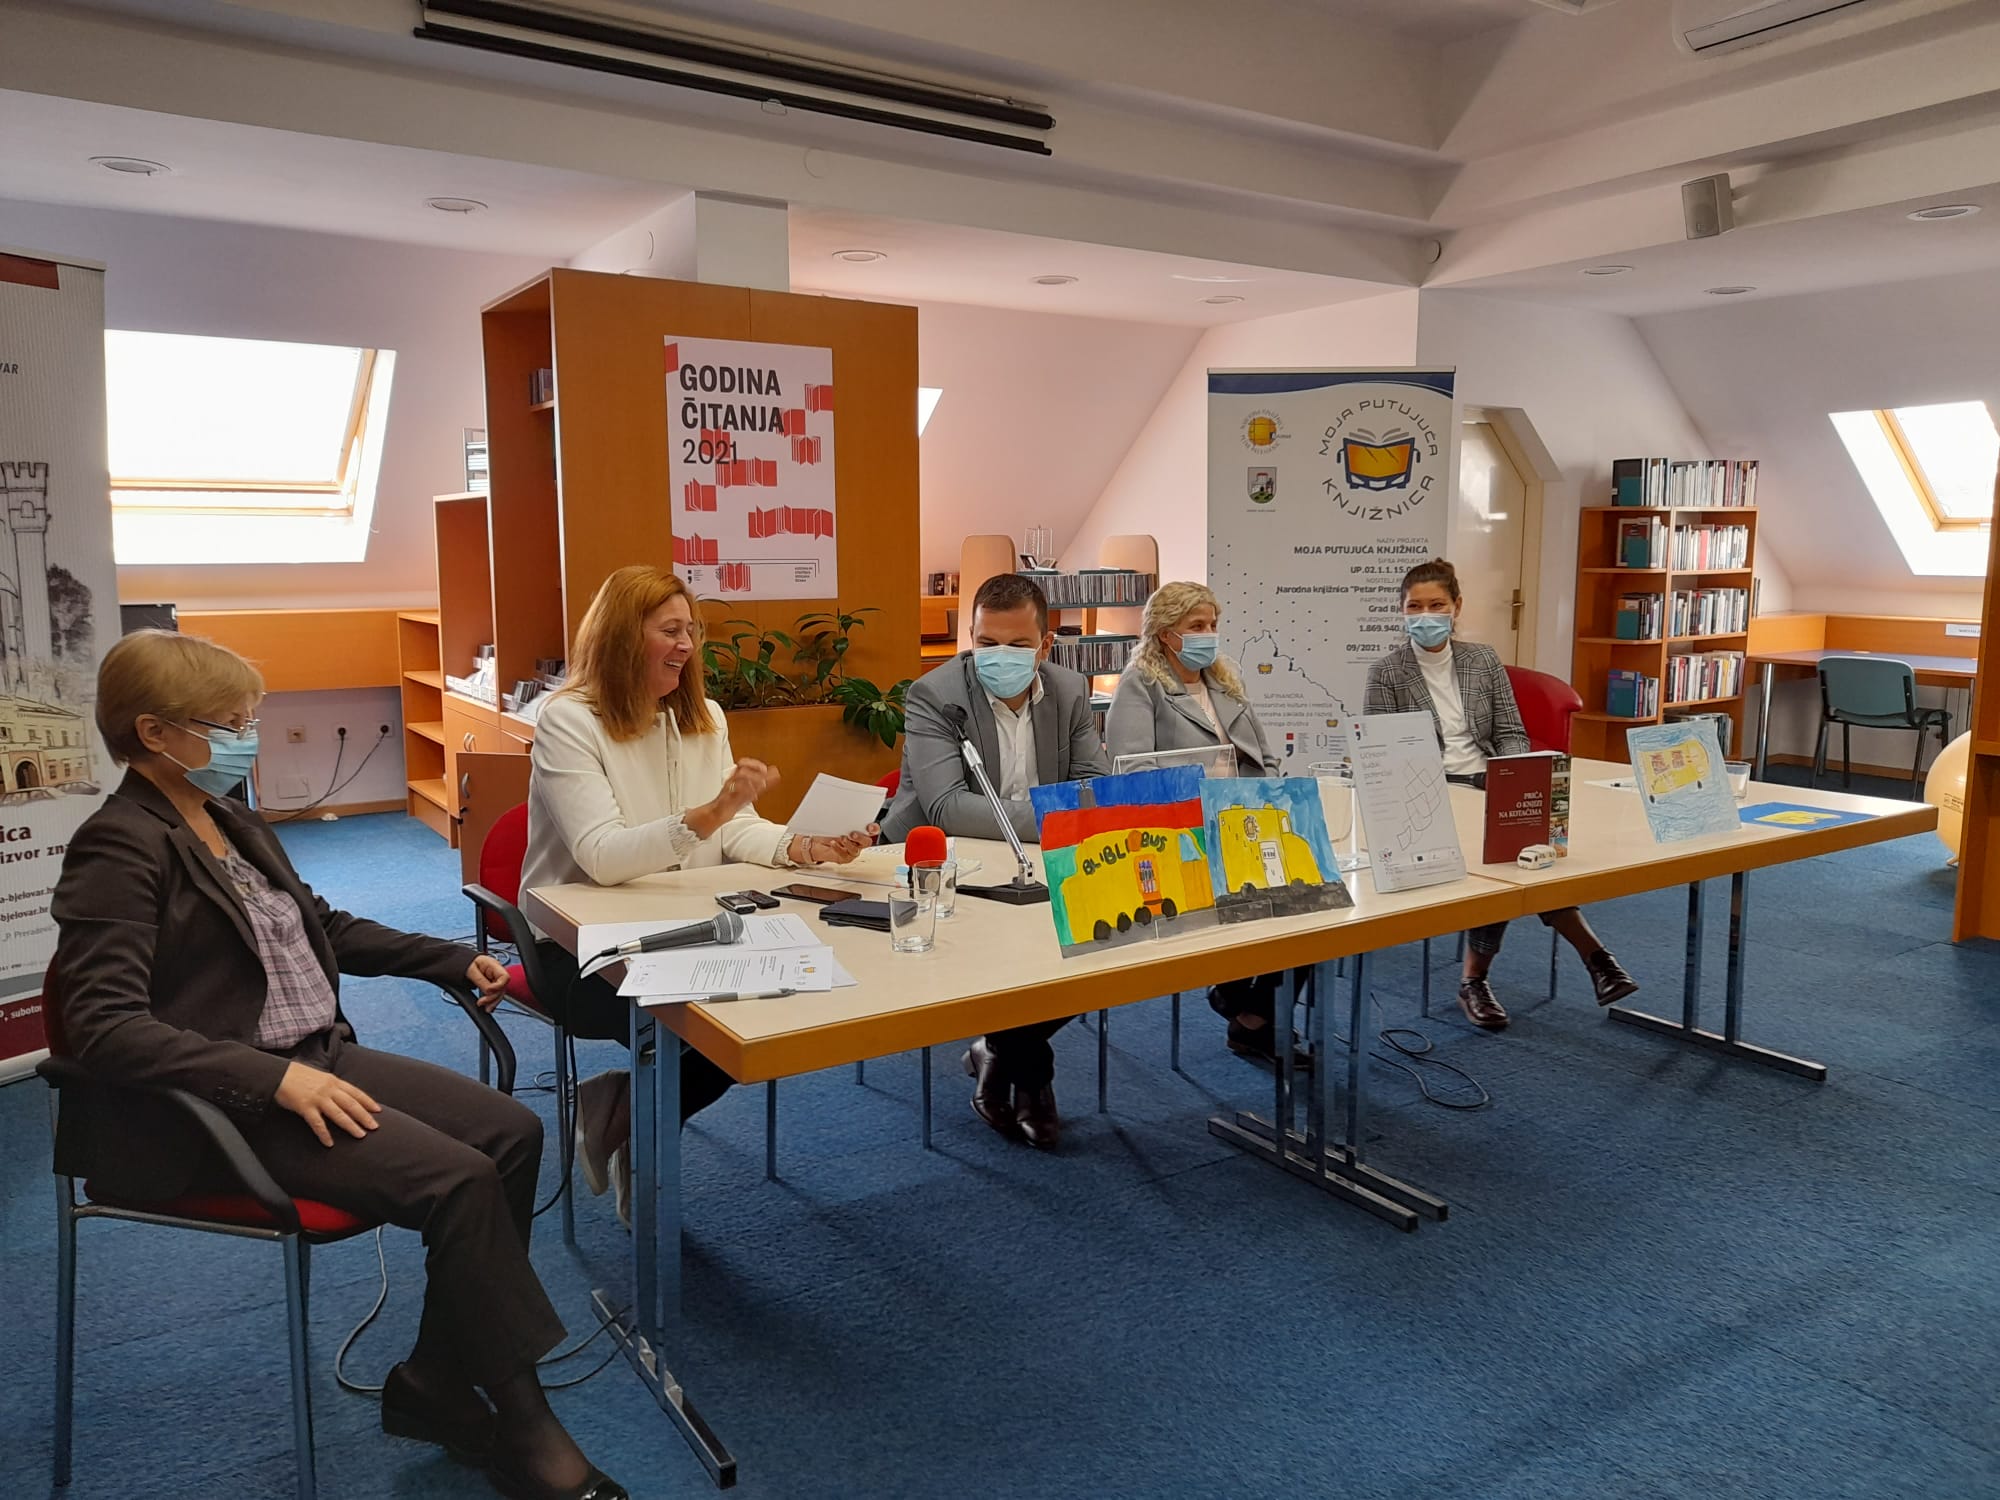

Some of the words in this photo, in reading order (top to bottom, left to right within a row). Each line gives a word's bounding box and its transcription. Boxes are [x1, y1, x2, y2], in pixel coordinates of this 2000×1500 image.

[679, 363, 781, 396] GODINA
[1319, 408, 1354, 456] MOJA
[1359, 399, 1439, 456] PUTUJUĆA
[682, 438, 738, 465] 2021
[1322, 475, 1435, 521] KNJIŽNICA
[1294, 545, 1322, 554] MOJA
[1324, 544, 1374, 554] PUTUJUĆA
[1376, 544, 1428, 554] KNJIŽNICA
[1277, 585, 1312, 594] Narodna
[1378, 585, 1402, 593] Prera
[1368, 605, 1389, 613] Grad
[1346, 644, 1380, 652] 09/2021
[0, 849, 40, 864] izvor
[11, 1005, 43, 1019] suboto
